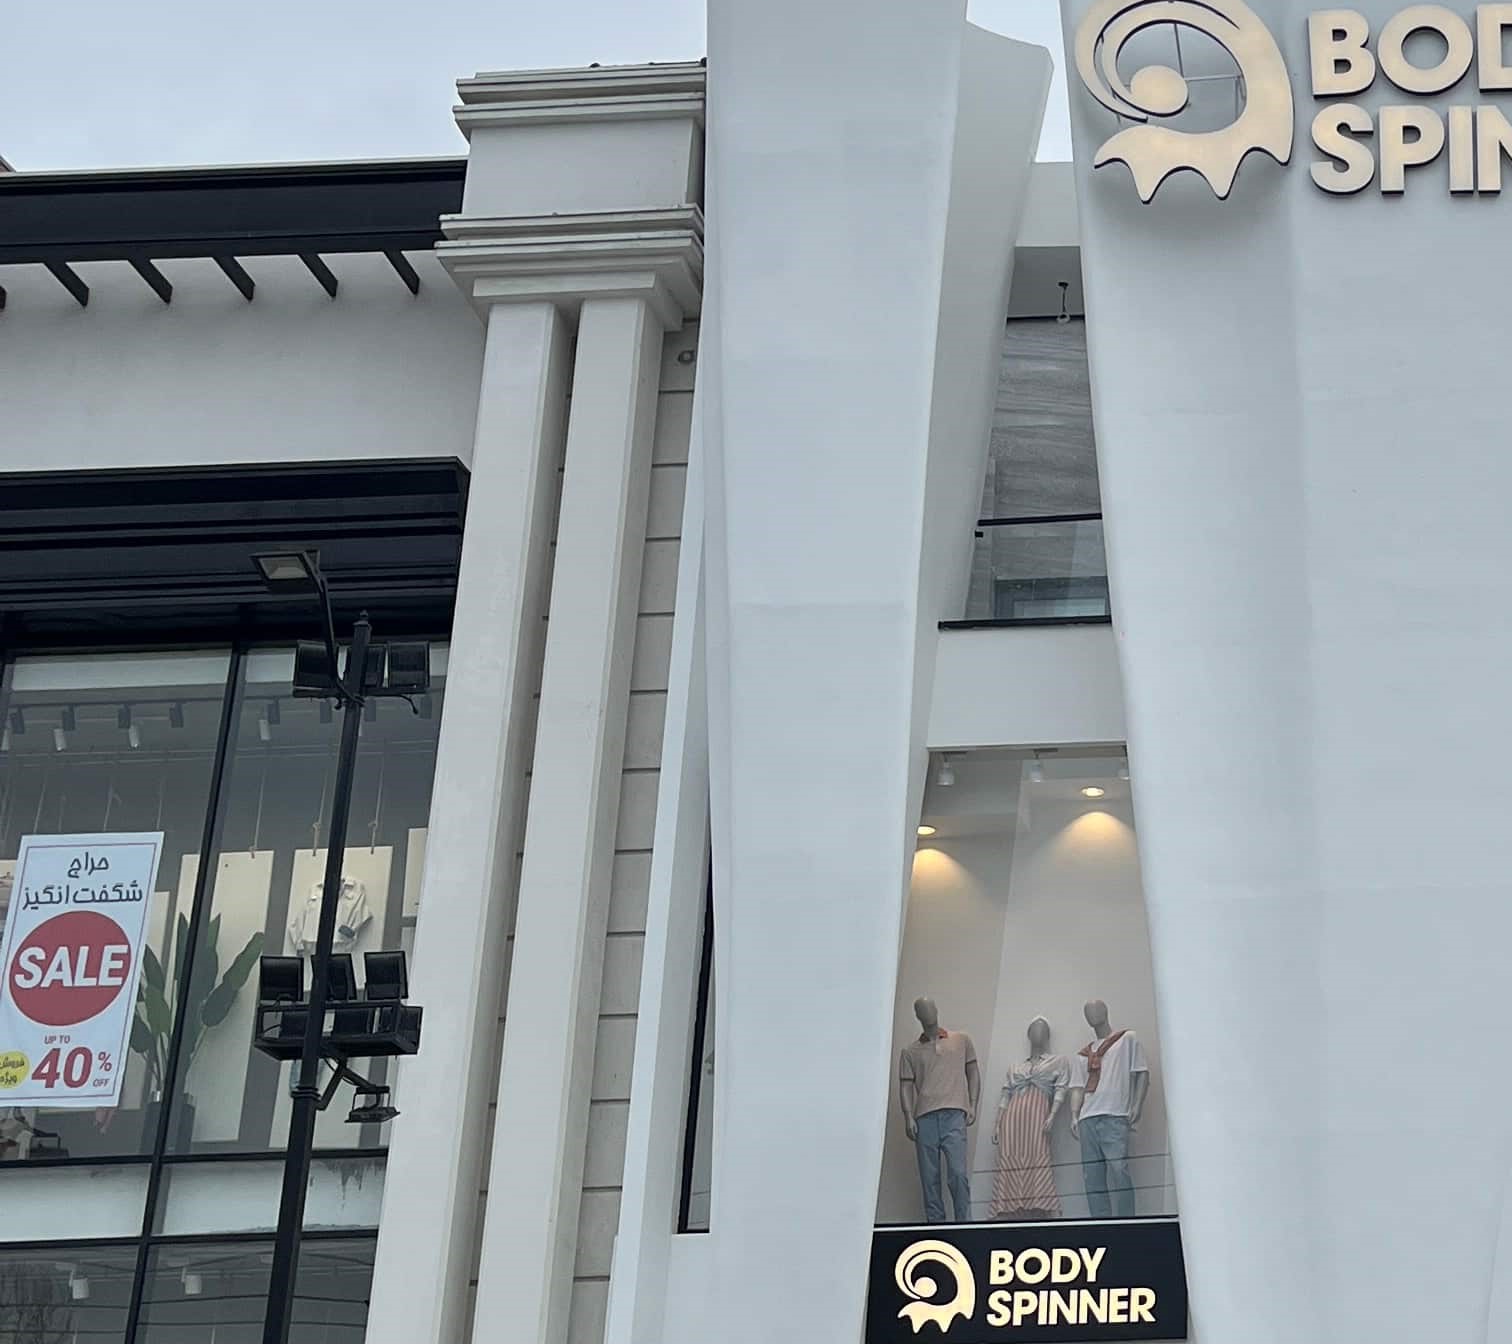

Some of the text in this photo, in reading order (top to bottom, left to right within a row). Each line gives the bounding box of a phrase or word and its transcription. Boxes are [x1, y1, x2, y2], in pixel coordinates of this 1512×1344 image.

[67, 851, 109, 879] حراج
[14, 944, 129, 989] SALE
[44, 1034, 71, 1045] UP TO
[92, 1078, 111, 1088] OFF
[989, 1247, 1107, 1285] BODY
[986, 1287, 1157, 1327] SPINNER
